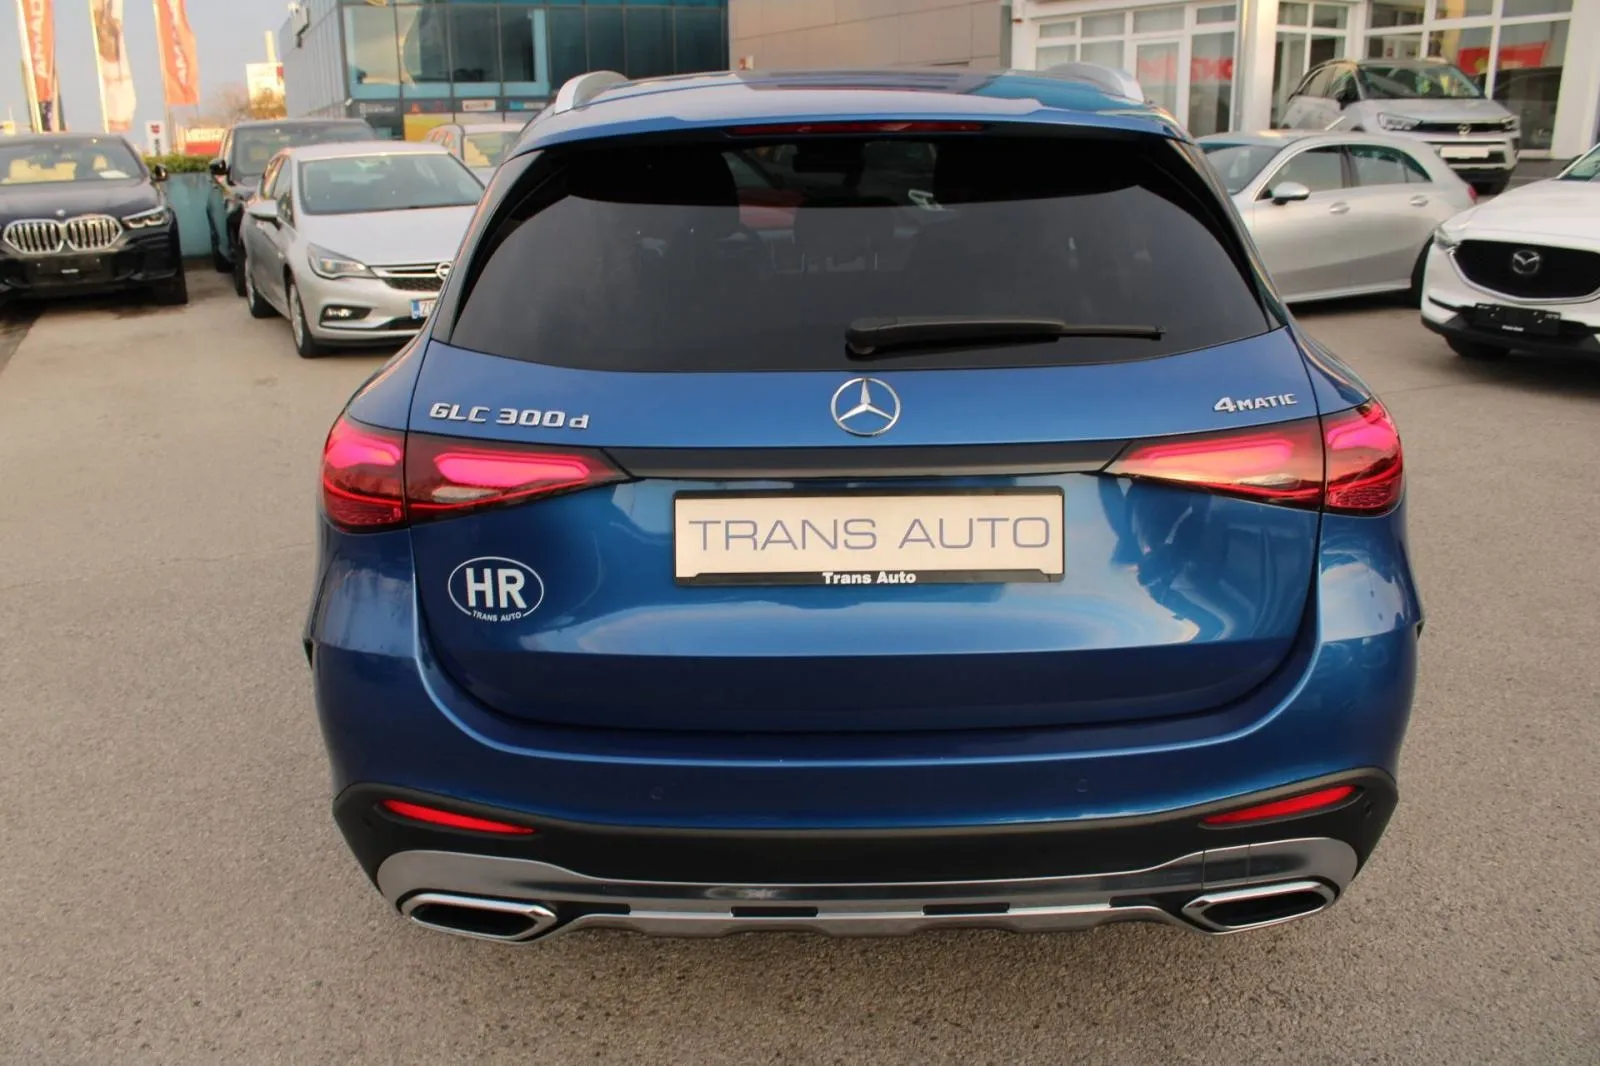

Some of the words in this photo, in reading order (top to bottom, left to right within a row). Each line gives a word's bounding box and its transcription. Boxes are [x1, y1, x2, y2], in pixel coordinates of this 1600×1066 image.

[429, 402, 490, 423] GLC
[1213, 393, 1298, 412] 4MATIC
[688, 518, 877, 551] TRANS
[899, 516, 1050, 550] AUTO
[822, 571, 872, 584] Trans
[877, 571, 917, 584] Auto
[465, 567, 527, 609] HR
[472, 610, 498, 622] TRANS
[500, 611, 522, 622] AUTO
